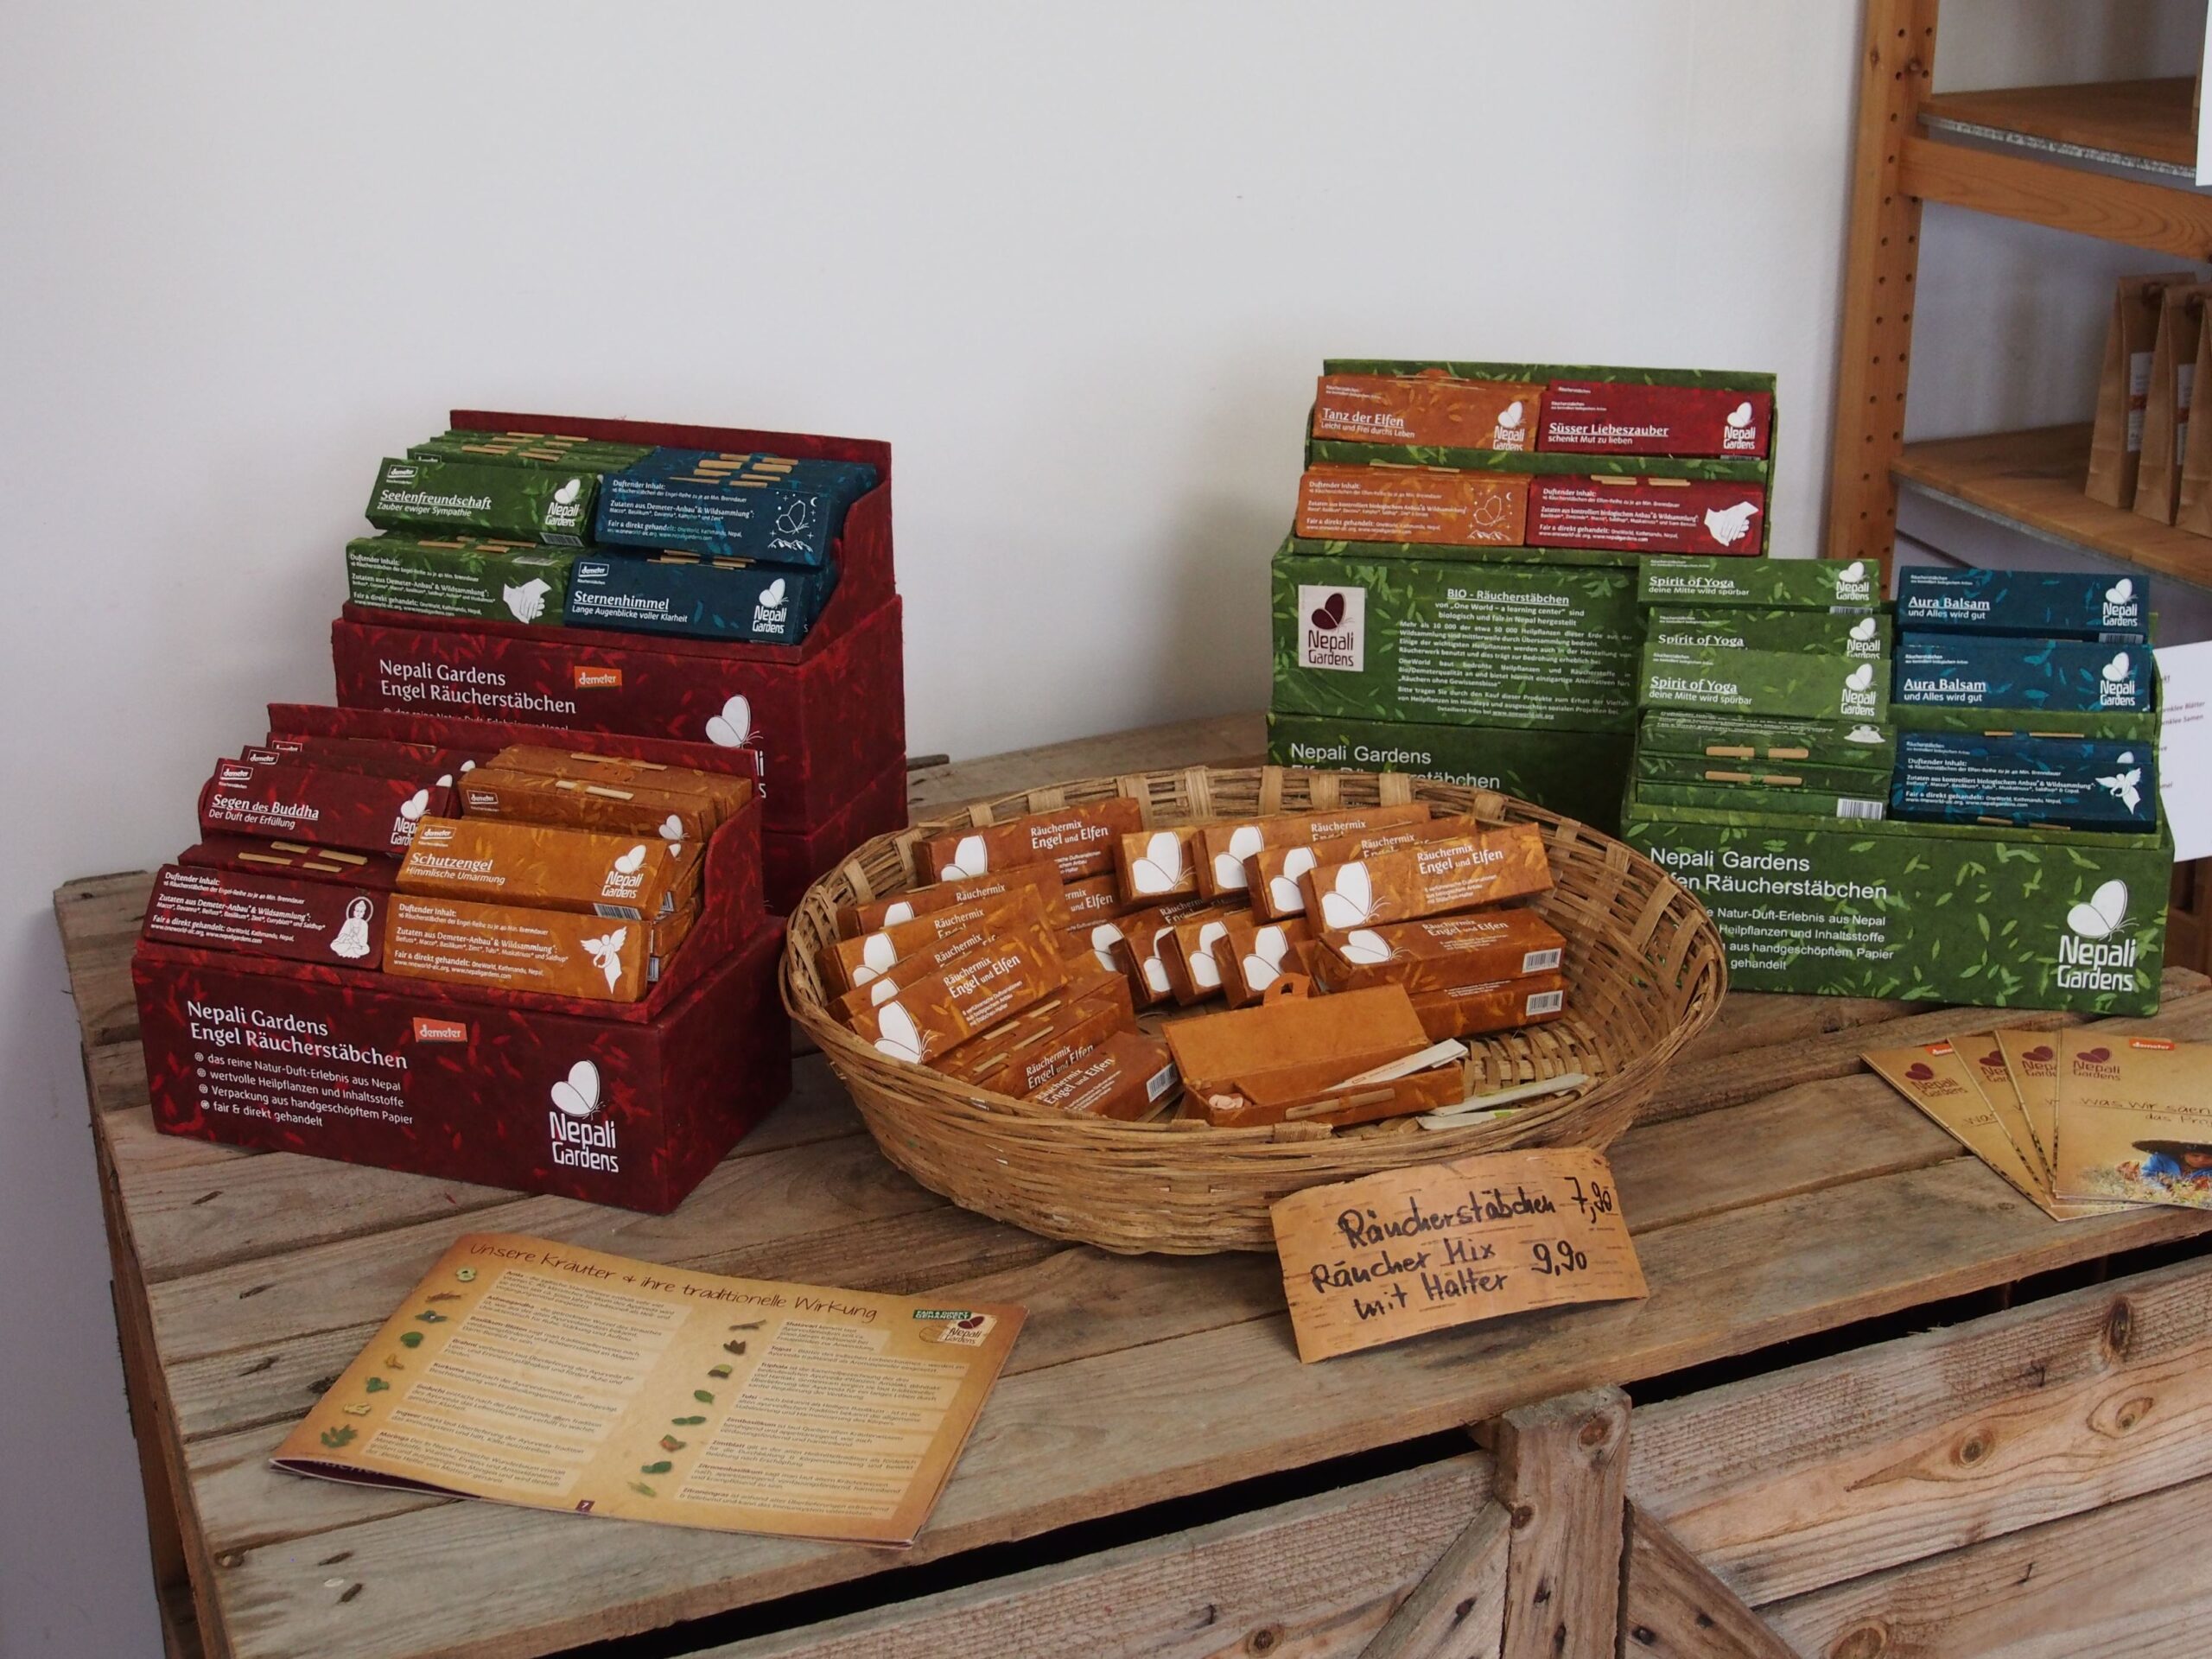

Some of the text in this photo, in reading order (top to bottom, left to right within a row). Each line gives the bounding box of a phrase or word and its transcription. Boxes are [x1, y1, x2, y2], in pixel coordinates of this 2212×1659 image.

[1323, 408, 1404, 427] Tanz der Elfen
[1321, 421, 1341, 429] Leicht
[1371, 425, 1393, 435] durchs
[1394, 429, 1414, 438] Leben
[1549, 423, 1669, 436] Süsser Liebeszauber
[1725, 426, 1755, 441] Nepali
[1724, 439, 1755, 449] Gardens
[380, 489, 492, 510] Seelenfreundschaft
[377, 502, 472, 518] Zauber ewiger Sympathie
[574, 590, 669, 610] Sternenhimmel
[1447, 588, 1569, 604] BIO Räucherstäbchen
[572, 606, 688, 622] Lange Augenblicke voller Klarheit
[754, 606, 787, 622] Nepali
[1507, 606, 1536, 614] learning
[752, 620, 785, 633] Gardens
[1308, 630, 1354, 652] Nepali
[1308, 650, 1354, 666] Gardens
[379, 658, 506, 687] Nepali Gardens
[579, 672, 617, 686] demeter
[1650, 677, 1738, 694] Spirit of Yoga
[1904, 678, 1986, 692] Aura Balsam
[2100, 681, 2134, 696] Nepali
[381, 680, 576, 715] Engel Räucherstäbchen
[1649, 690, 1752, 705] deine Mitte wird spürbar
[1841, 690, 1876, 705] Nepali
[1923, 692, 1944, 702] Alles
[1968, 694, 1982, 702] gut
[2100, 695, 2135, 706] Gardens
[1840, 704, 1875, 716] Gardens
[1291, 743, 1432, 765] Nepali Gardens
[212, 793, 319, 820] Segen des Buddha
[209, 809, 296, 830] Der Duft der Erfüllung
[1031, 819, 1083, 837] Räuchermix
[1032, 825, 1109, 851] Engel und Elfen
[410, 852, 493, 873] Schutzengel
[1416, 844, 1474, 864] Räuchermix
[1420, 848, 1504, 875] Engel und Elfen
[1650, 848, 1810, 871] Nepali Gardens
[406, 867, 505, 885] Himmlische Umarmung
[605, 871, 644, 887] Nepali
[601, 884, 638, 899] Gardens
[1706, 874, 1887, 899] Räucherstäbchen
[399, 903, 457, 918] Duftender Inhalt:
[1718, 907, 1885, 927] Natur-Duft-Erlebnis aus Nepal
[1719, 925, 1885, 943] Heilpflanzen und Inhaltsstoffe
[394, 950, 406, 961] Fair
[414, 953, 432, 964] direkt
[434, 955, 470, 968] gehandelt:
[1752, 943, 1853, 957] handgeschöpftem
[1857, 949, 1894, 960] Papier
[2058, 935, 2136, 970] Nepali
[944, 956, 992, 987] Räuchermix
[1730, 958, 1787, 970] gehandelt
[950, 954, 1021, 1000] Engel und Elfen
[2056, 964, 2134, 992] Gardens
[186, 1000, 328, 1038] Nepali Gardens
[419, 1023, 461, 1039] demeter
[190, 1022, 408, 1071] Engel Räucherstäbchen
[2132, 1041, 2170, 1051] demeter
[207, 1052, 401, 1093] das reine Natur-Duft-Erlebnis aus Nepal
[2074, 1061, 2120, 1073] Nepali
[2074, 1069, 2121, 1080] Gardens
[210, 1070, 404, 1108] wertvolle Heilpflanzen und Inhaltsstoffe
[212, 1085, 413, 1126] Verpackung aus handgeschöpftem Papier
[213, 1100, 323, 1128] fair & direkt gehandelt
[549, 1111, 615, 1149] Nepali
[552, 1141, 619, 1173] Gardens
[1565, 1177, 1613, 1224] 7,90
[1311, 1238, 1586, 1293] Räucher Mix 9,90
[470, 1243, 878, 1324] Unsere Kräuter ihre traditionelle Wirkung
[1354, 1270, 1509, 1320] mit Halter
[949, 1327, 982, 1338] Nepali
